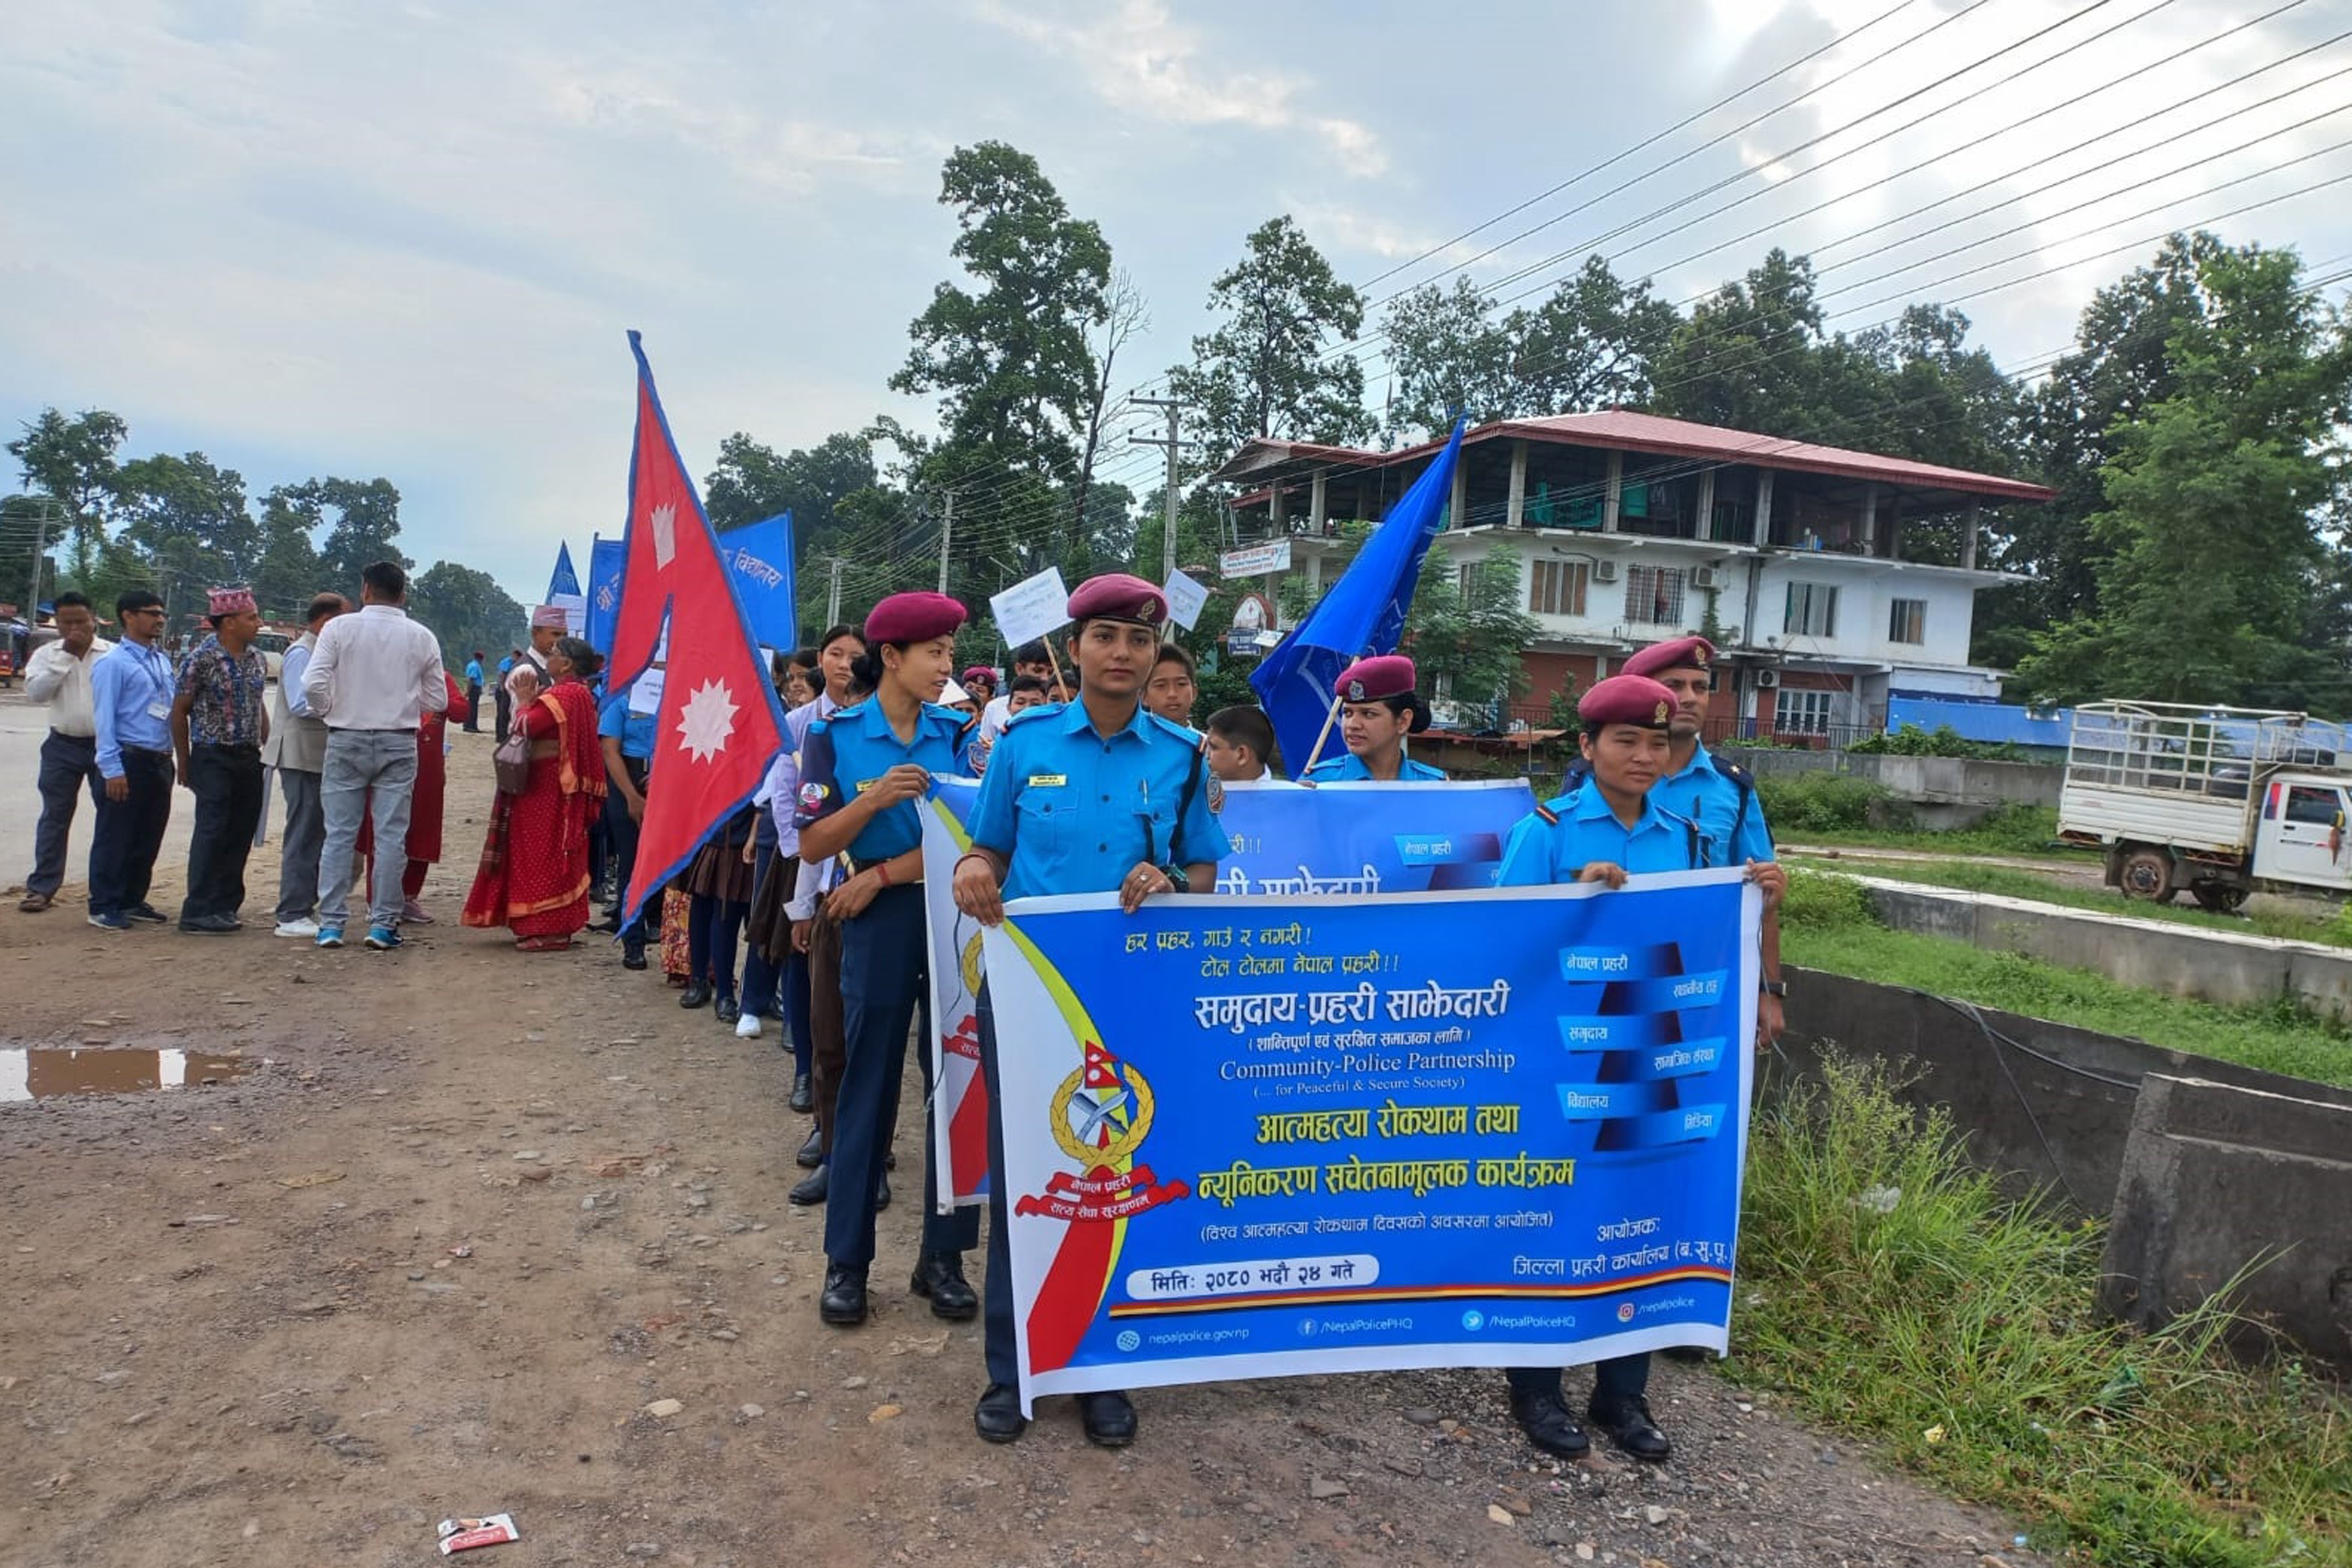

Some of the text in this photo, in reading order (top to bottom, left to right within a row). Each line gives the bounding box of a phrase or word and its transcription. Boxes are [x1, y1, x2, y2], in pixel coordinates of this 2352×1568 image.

[1125, 934, 1148, 953] हर
[1241, 930, 1252, 947] र
[1201, 955, 1230, 977] टोल
[1239, 953, 1285, 976] टोलमा
[1293, 952, 1333, 974] नेपाल
[1602, 953, 1628, 971] प्रहरी
[1194, 981, 1378, 1034] समुदाय-प्रहरी
[1333, 1029, 1377, 1051] सुरक्षित
[1220, 1048, 1516, 1080] Community-Police Partnership
[1276, 1084, 1292, 1096] for
[1297, 1080, 1349, 1094] Peaceful
[1353, 1080, 1364, 1091] &
[1369, 1078, 1409, 1090] Secure
[1414, 1075, 1465, 1090] Society)
[1567, 1092, 1609, 1109] विद्यालय
[1256, 1100, 1520, 1144] आत्महत्या रोकथाम तथा
[1198, 1151, 1576, 1207] न्यूनिकरण सचेतनामूलक कार्यक्रम
[1243, 1221, 1309, 1238] आत्महत्या
[1314, 1217, 1368, 1234] रोकथाम
[1373, 1211, 1426, 1231] दिवसको
[1430, 1214, 1490, 1230] अवसरमा
[1513, 1256, 1564, 1276] जिल्ला
[1571, 1254, 1608, 1277] प्रहरी
[1612, 1243, 1670, 1270] कार्यालय
[1205, 1270, 1250, 1291] २०८०
[1260, 1261, 1291, 1284] भदौ
[1298, 1266, 1320, 1284] २४
[1330, 1260, 1356, 1279] गते
